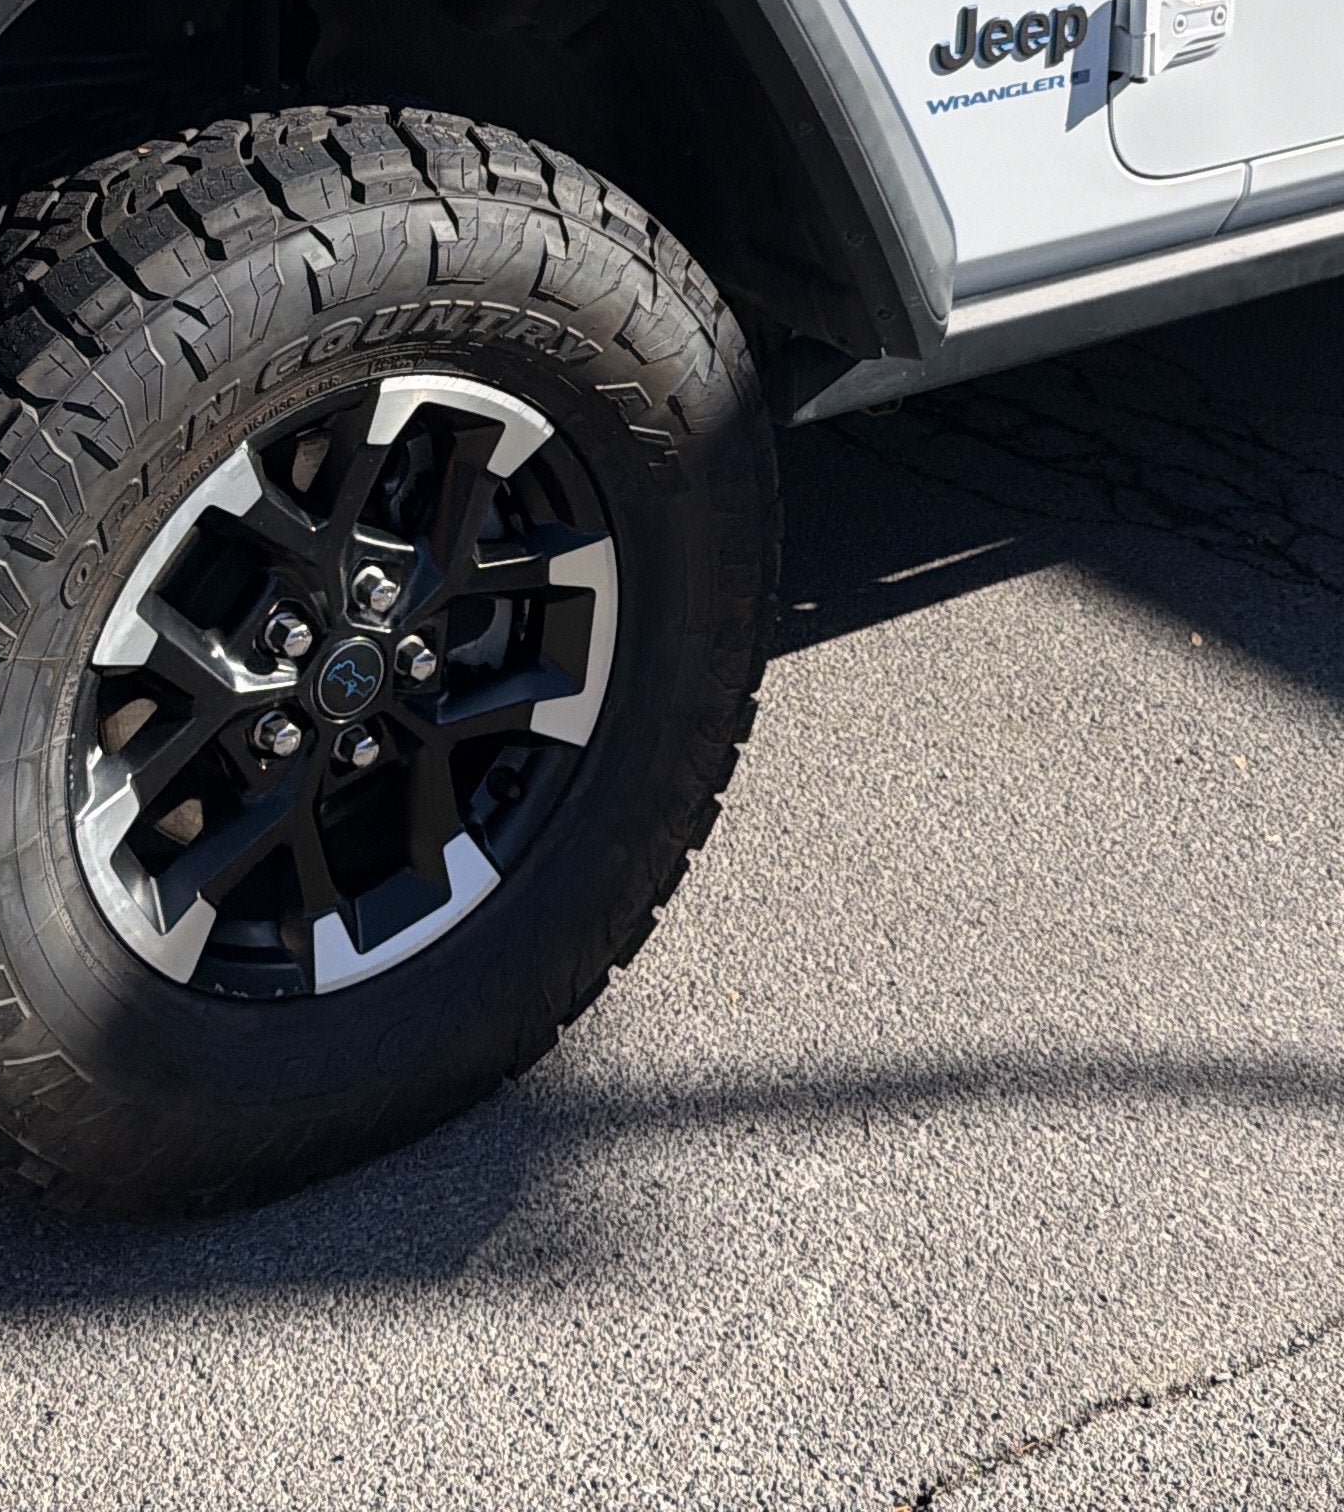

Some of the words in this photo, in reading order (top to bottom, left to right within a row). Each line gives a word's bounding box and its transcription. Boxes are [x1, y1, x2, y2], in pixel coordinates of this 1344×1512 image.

[929, 3, 1088, 76] Jeep
[926, 74, 1065, 115] WRANGLER
[59, 378, 242, 611] OPEN
[255, 299, 604, 394] COUNTRY
